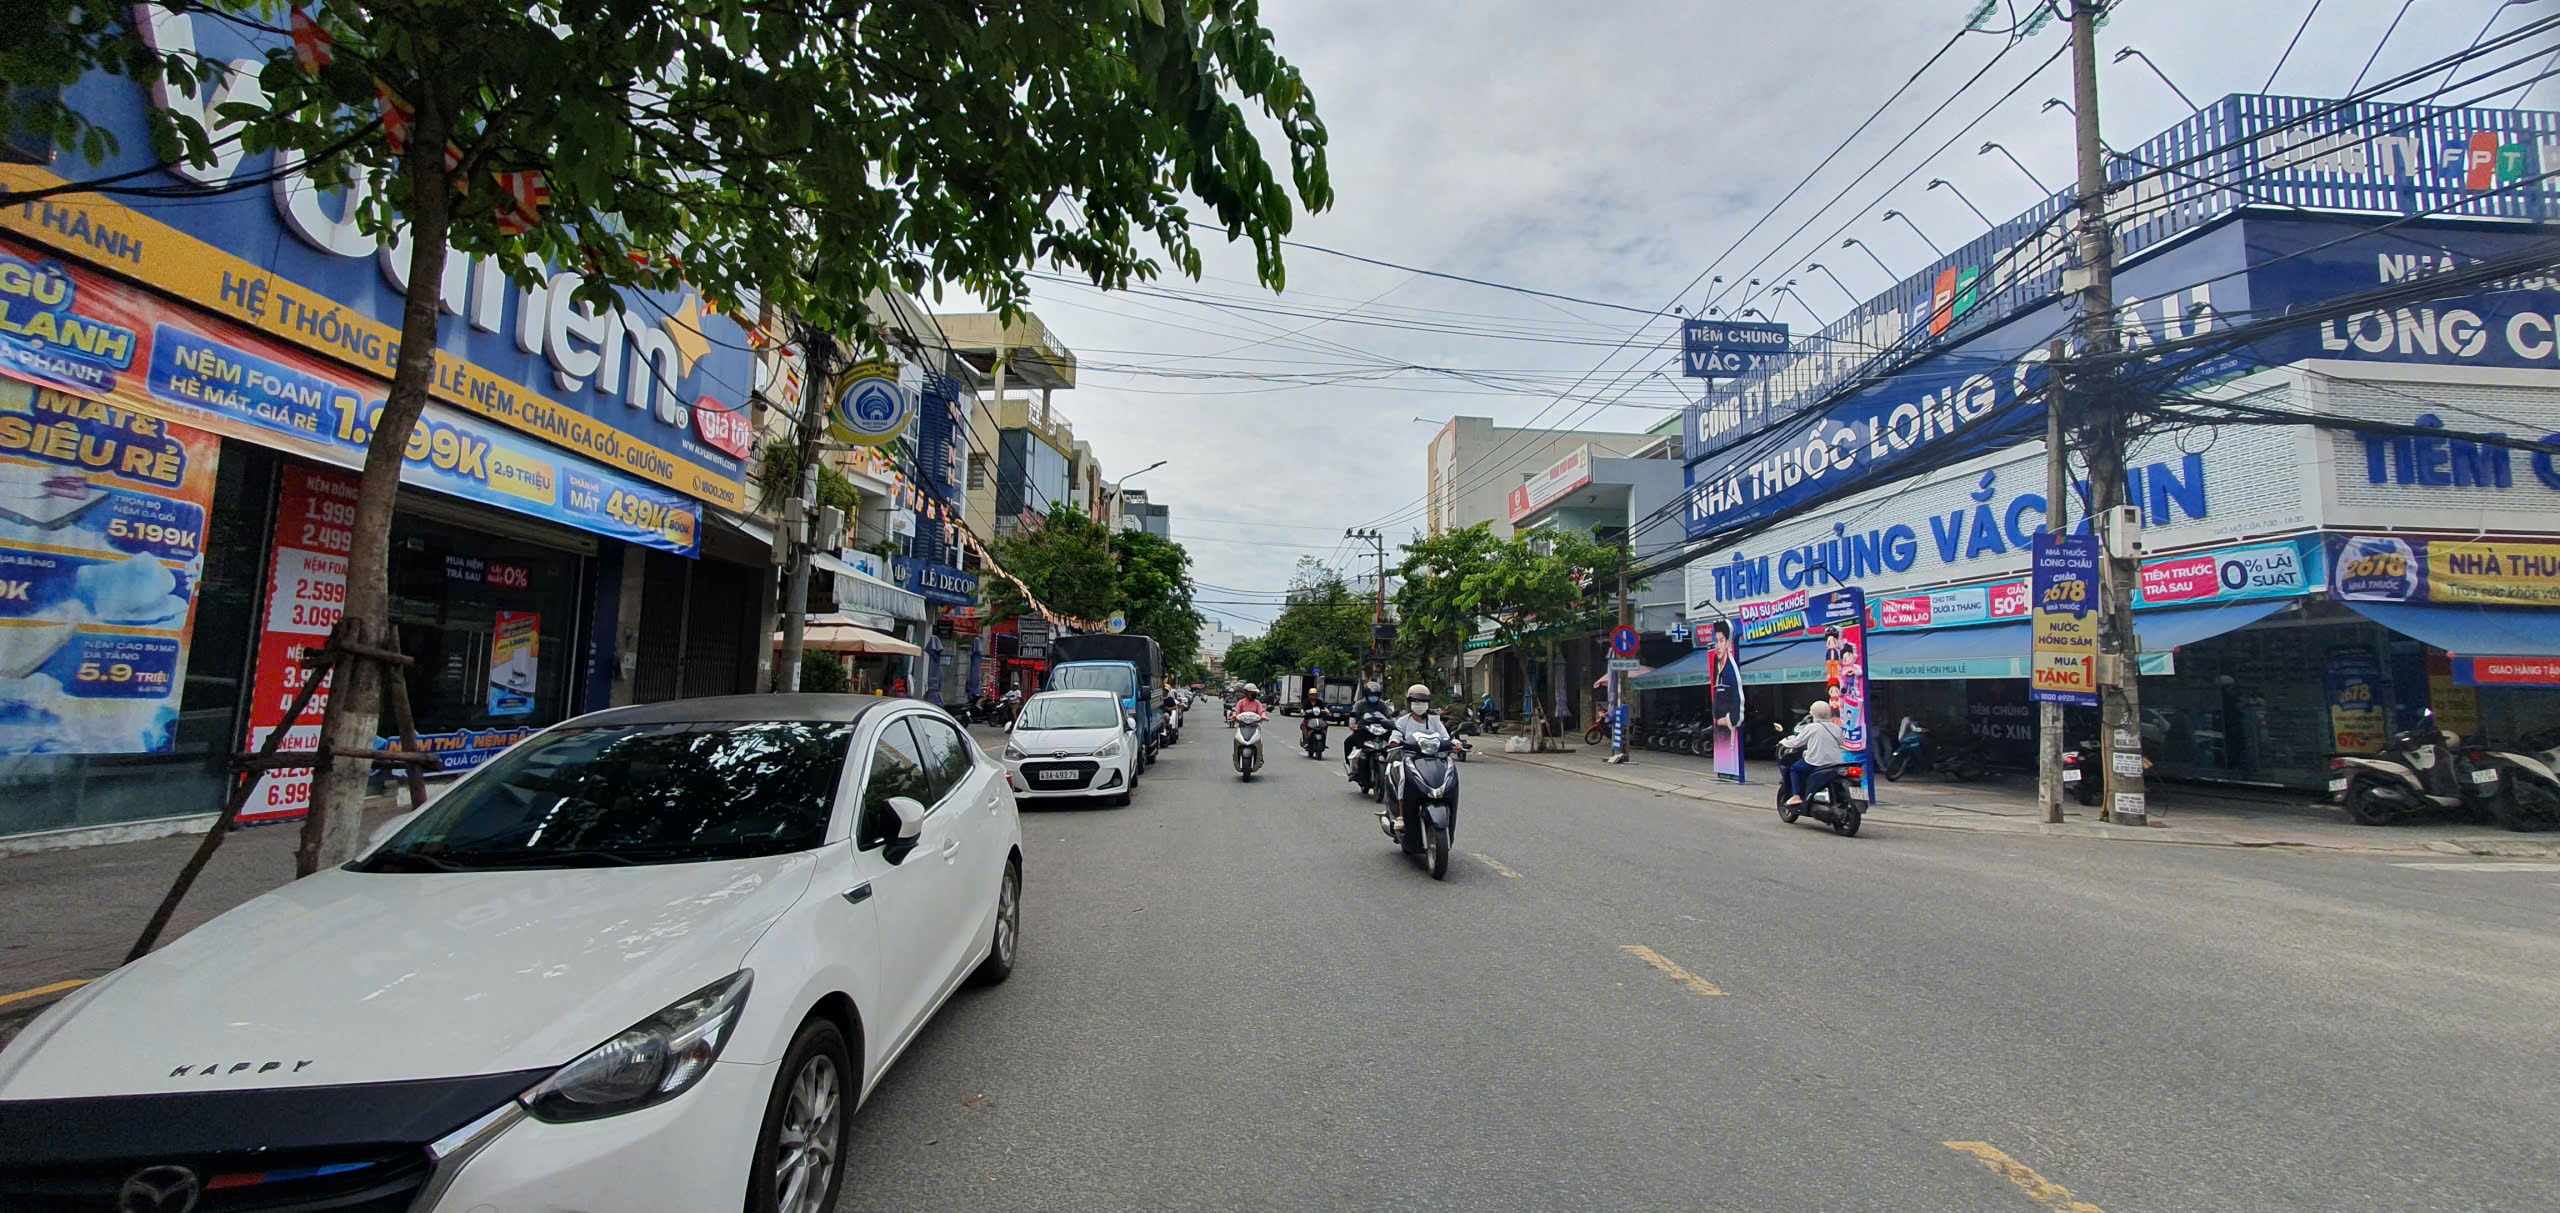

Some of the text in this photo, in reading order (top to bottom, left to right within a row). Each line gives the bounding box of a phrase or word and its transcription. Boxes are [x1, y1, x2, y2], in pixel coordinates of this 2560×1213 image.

[2261, 125, 2366, 174] CÔNG
[2375, 136, 2420, 176] TY
[2440, 140, 2524, 182] FPT
[23, 200, 143, 264] THÀNH
[219, 271, 380, 361] HỆ THỐNG
[1690, 325, 1723, 342] TIÊM
[2320, 308, 2486, 357] LONG
[1691, 345, 1740, 371] VẮC
[175, 345, 321, 410] NỆM FOAM
[170, 374, 200, 398] HÈ
[256, 402, 290, 425] GIÁ
[293, 411, 317, 432] RẺ
[440, 365, 468, 396] LẺ
[571, 423, 592, 450] GA
[1744, 381, 1766, 419] TY
[705, 411, 749, 451] giá tốt
[0, 416, 181, 482] SIÊU RẺ
[1692, 464, 1744, 520] NHÀ
[1749, 418, 1857, 500] THUỐC
[1869, 373, 1997, 459] LONG
[2354, 413, 2513, 488] TIÊM
[494, 460, 513, 479] 2.9
[516, 467, 551, 491] TRIỆU
[570, 489, 600, 513] MÁT
[607, 489, 668, 534] 439K
[109, 518, 196, 548] 5.199K
[302, 523, 352, 551] 2.499
[1712, 469, 2048, 602] TIÊM CHỦNG VẮC
[303, 557, 326, 574] NỆM
[2040, 558, 2092, 568] LONG CHÂU
[2143, 563, 2214, 582] TIÊM TRƯỚC
[2265, 553, 2293, 570] LÃI
[2449, 547, 2502, 576] NHÀ
[464, 570, 482, 582] SAU
[504, 566, 528, 587] 0%
[921, 567, 937, 587] LÊ
[2220, 558, 2263, 590] 0%
[2252, 568, 2297, 587] SUẤT
[296, 578, 344, 603] 2.599
[2043, 580, 2085, 603] 2678
[2144, 581, 2193, 595] TRẢ SAU
[292, 604, 342, 627] 3.099
[1899, 613, 1912, 622] XIN
[1913, 612, 1929, 622] LAO
[2050, 621, 2079, 633] NƯỚC
[77, 662, 132, 682] 5.9
[2035, 667, 2080, 687] TẶNG
[2054, 655, 2094, 687] MUA 1
[2488, 665, 2513, 675] GIAO
[2514, 664, 2542, 676] HÀNG
[473, 732, 507, 749] NỆM
[2005, 723, 2032, 741] XIN
[444, 755, 468, 767] QUÀ
[168, 1059, 314, 1078] HAPPY
